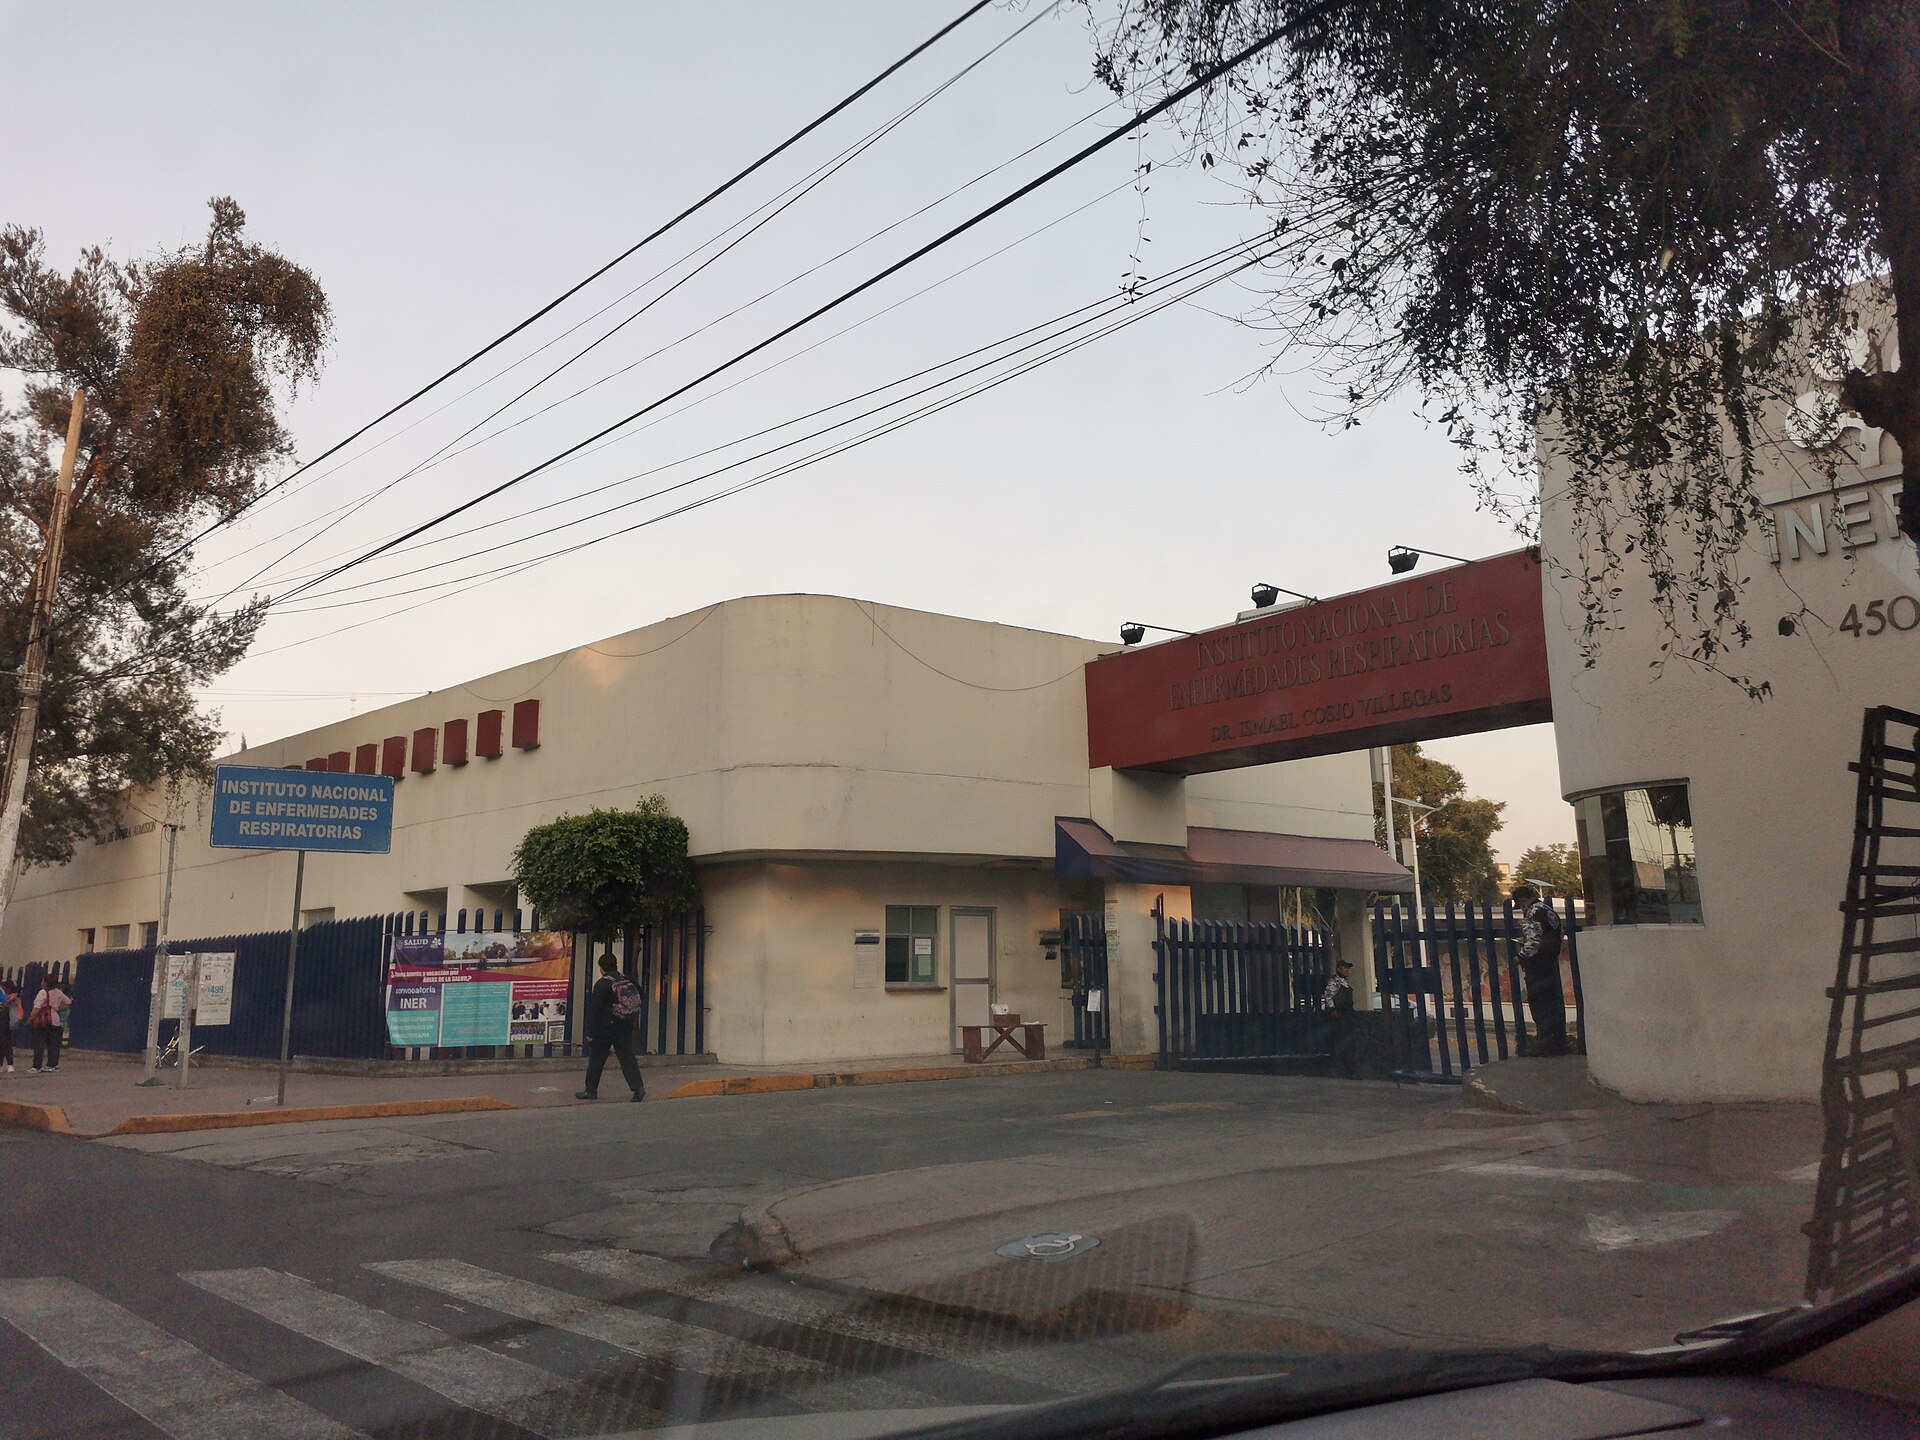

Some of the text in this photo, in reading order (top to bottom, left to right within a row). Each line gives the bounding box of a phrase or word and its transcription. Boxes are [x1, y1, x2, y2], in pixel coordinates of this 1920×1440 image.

[1196, 579, 1458, 671] INSTITUTO NACIONAL DE
[1840, 595, 1920, 637] 450
[1167, 613, 1512, 713] ENFERMEDADES RESPIRATORIAS
[1210, 725, 1236, 744] DR.
[1240, 714, 1298, 739] ISMAEL
[1358, 684, 1453, 717] VILLEGAS
[221, 779, 388, 802] INSTITUTO NACIONAL
[229, 800, 378, 821] DE ENFERMEDADES
[239, 821, 362, 840] RESPIRATORIAS
[404, 938, 429, 946] SALUD
[400, 997, 428, 1009] INER
